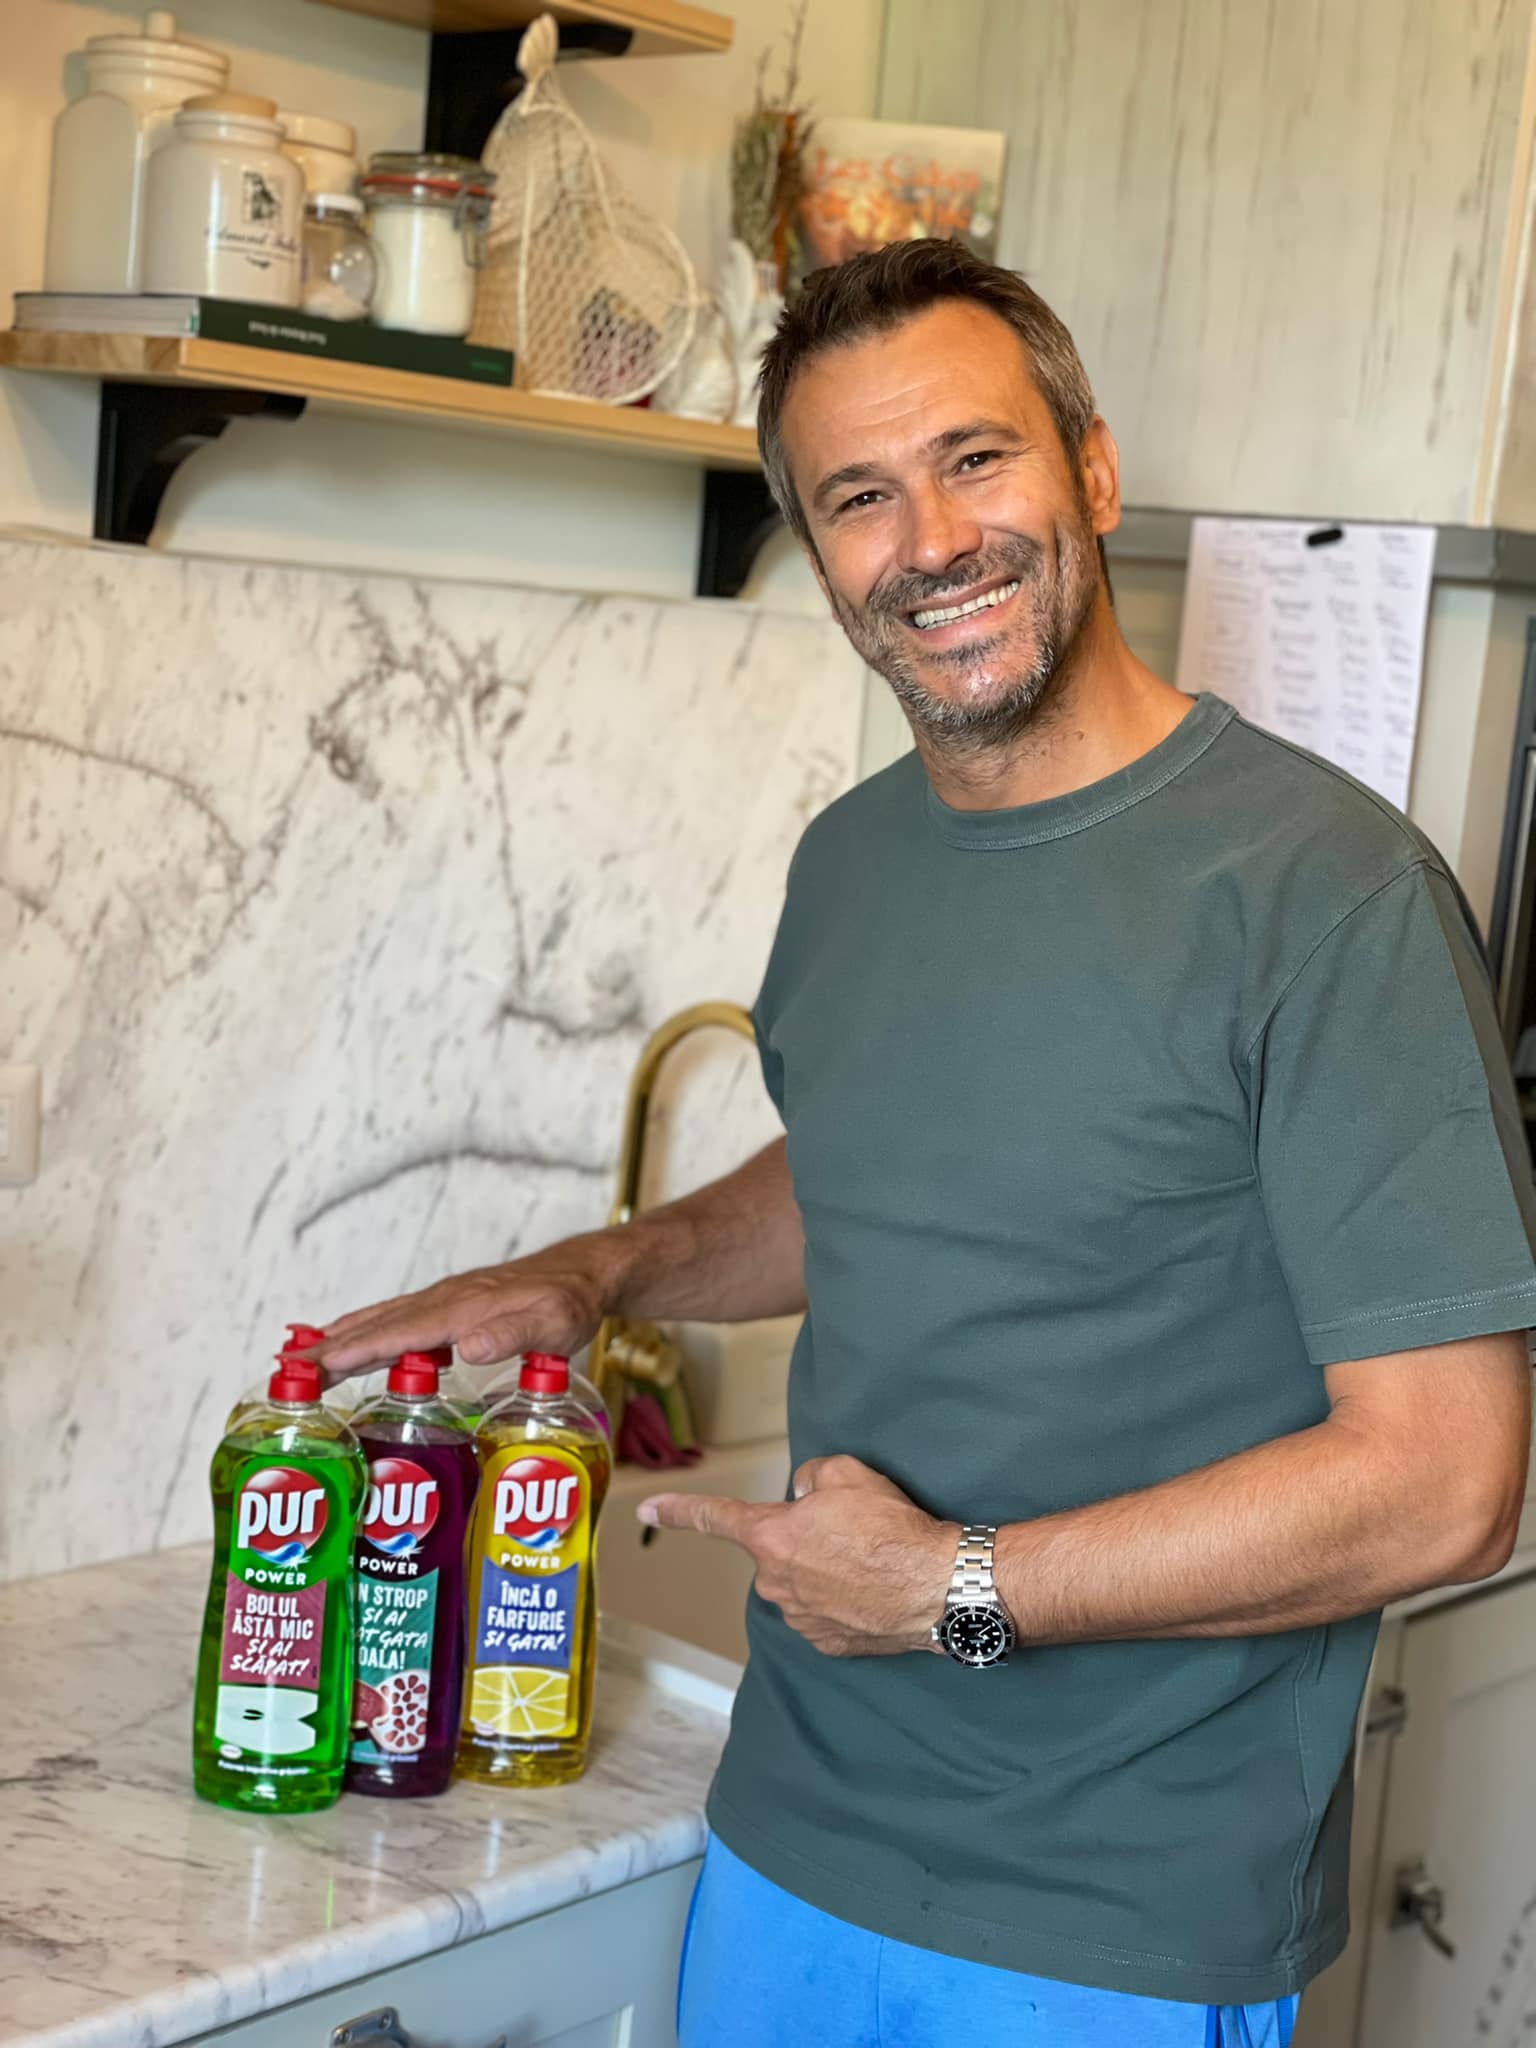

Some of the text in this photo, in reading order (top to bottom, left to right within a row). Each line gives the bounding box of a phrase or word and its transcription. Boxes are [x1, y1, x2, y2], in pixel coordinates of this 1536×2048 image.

[493, 1475, 578, 1535] pur
[237, 1488, 325, 1548] pur
[360, 1556, 418, 1575] POWER
[501, 1552, 560, 1569] POWER
[245, 1567, 307, 1585] POWER
[246, 1593, 300, 1617] BOLUL
[373, 1585, 428, 1609] STROP
[501, 1580, 557, 1609] ÎNCĂ O
[232, 1608, 314, 1640] ĂSTA MIC
[384, 1610, 408, 1626] AI
[487, 1606, 566, 1632] FARFURIE
[269, 1640, 294, 1657] AI
[380, 1630, 428, 1649] GATA
[507, 1633, 566, 1653] GATA!
